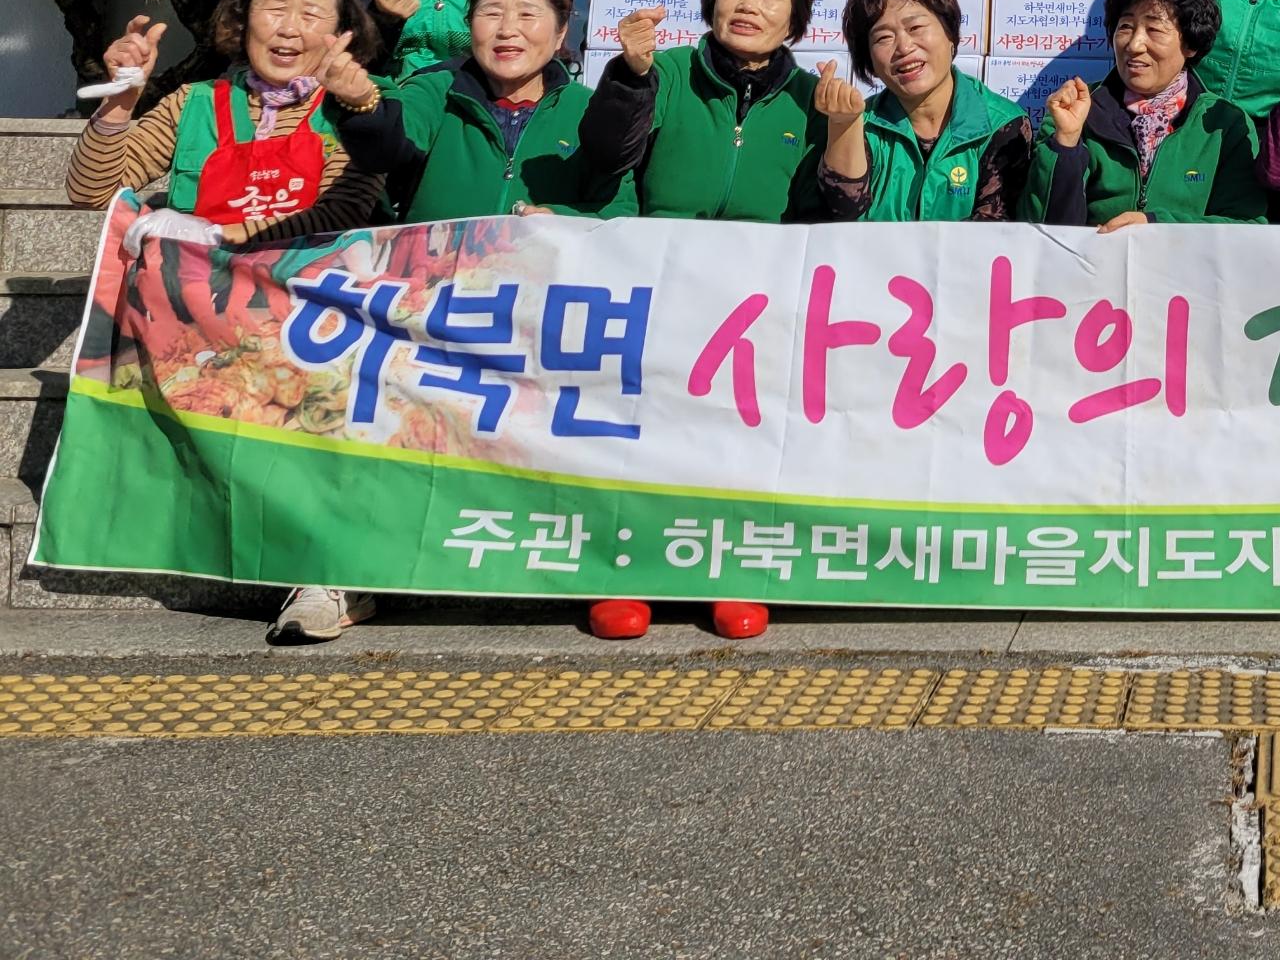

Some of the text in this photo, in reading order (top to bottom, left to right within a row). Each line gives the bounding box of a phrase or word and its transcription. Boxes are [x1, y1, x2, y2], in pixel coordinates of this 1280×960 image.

[1024, 1, 1088, 14] 하북면새마을
[1183, 172, 1206, 183] SMU
[288, 272, 652, 440] 하북면
[688, 256, 1188, 466] 사랑의
[443, 508, 592, 574] 주관
